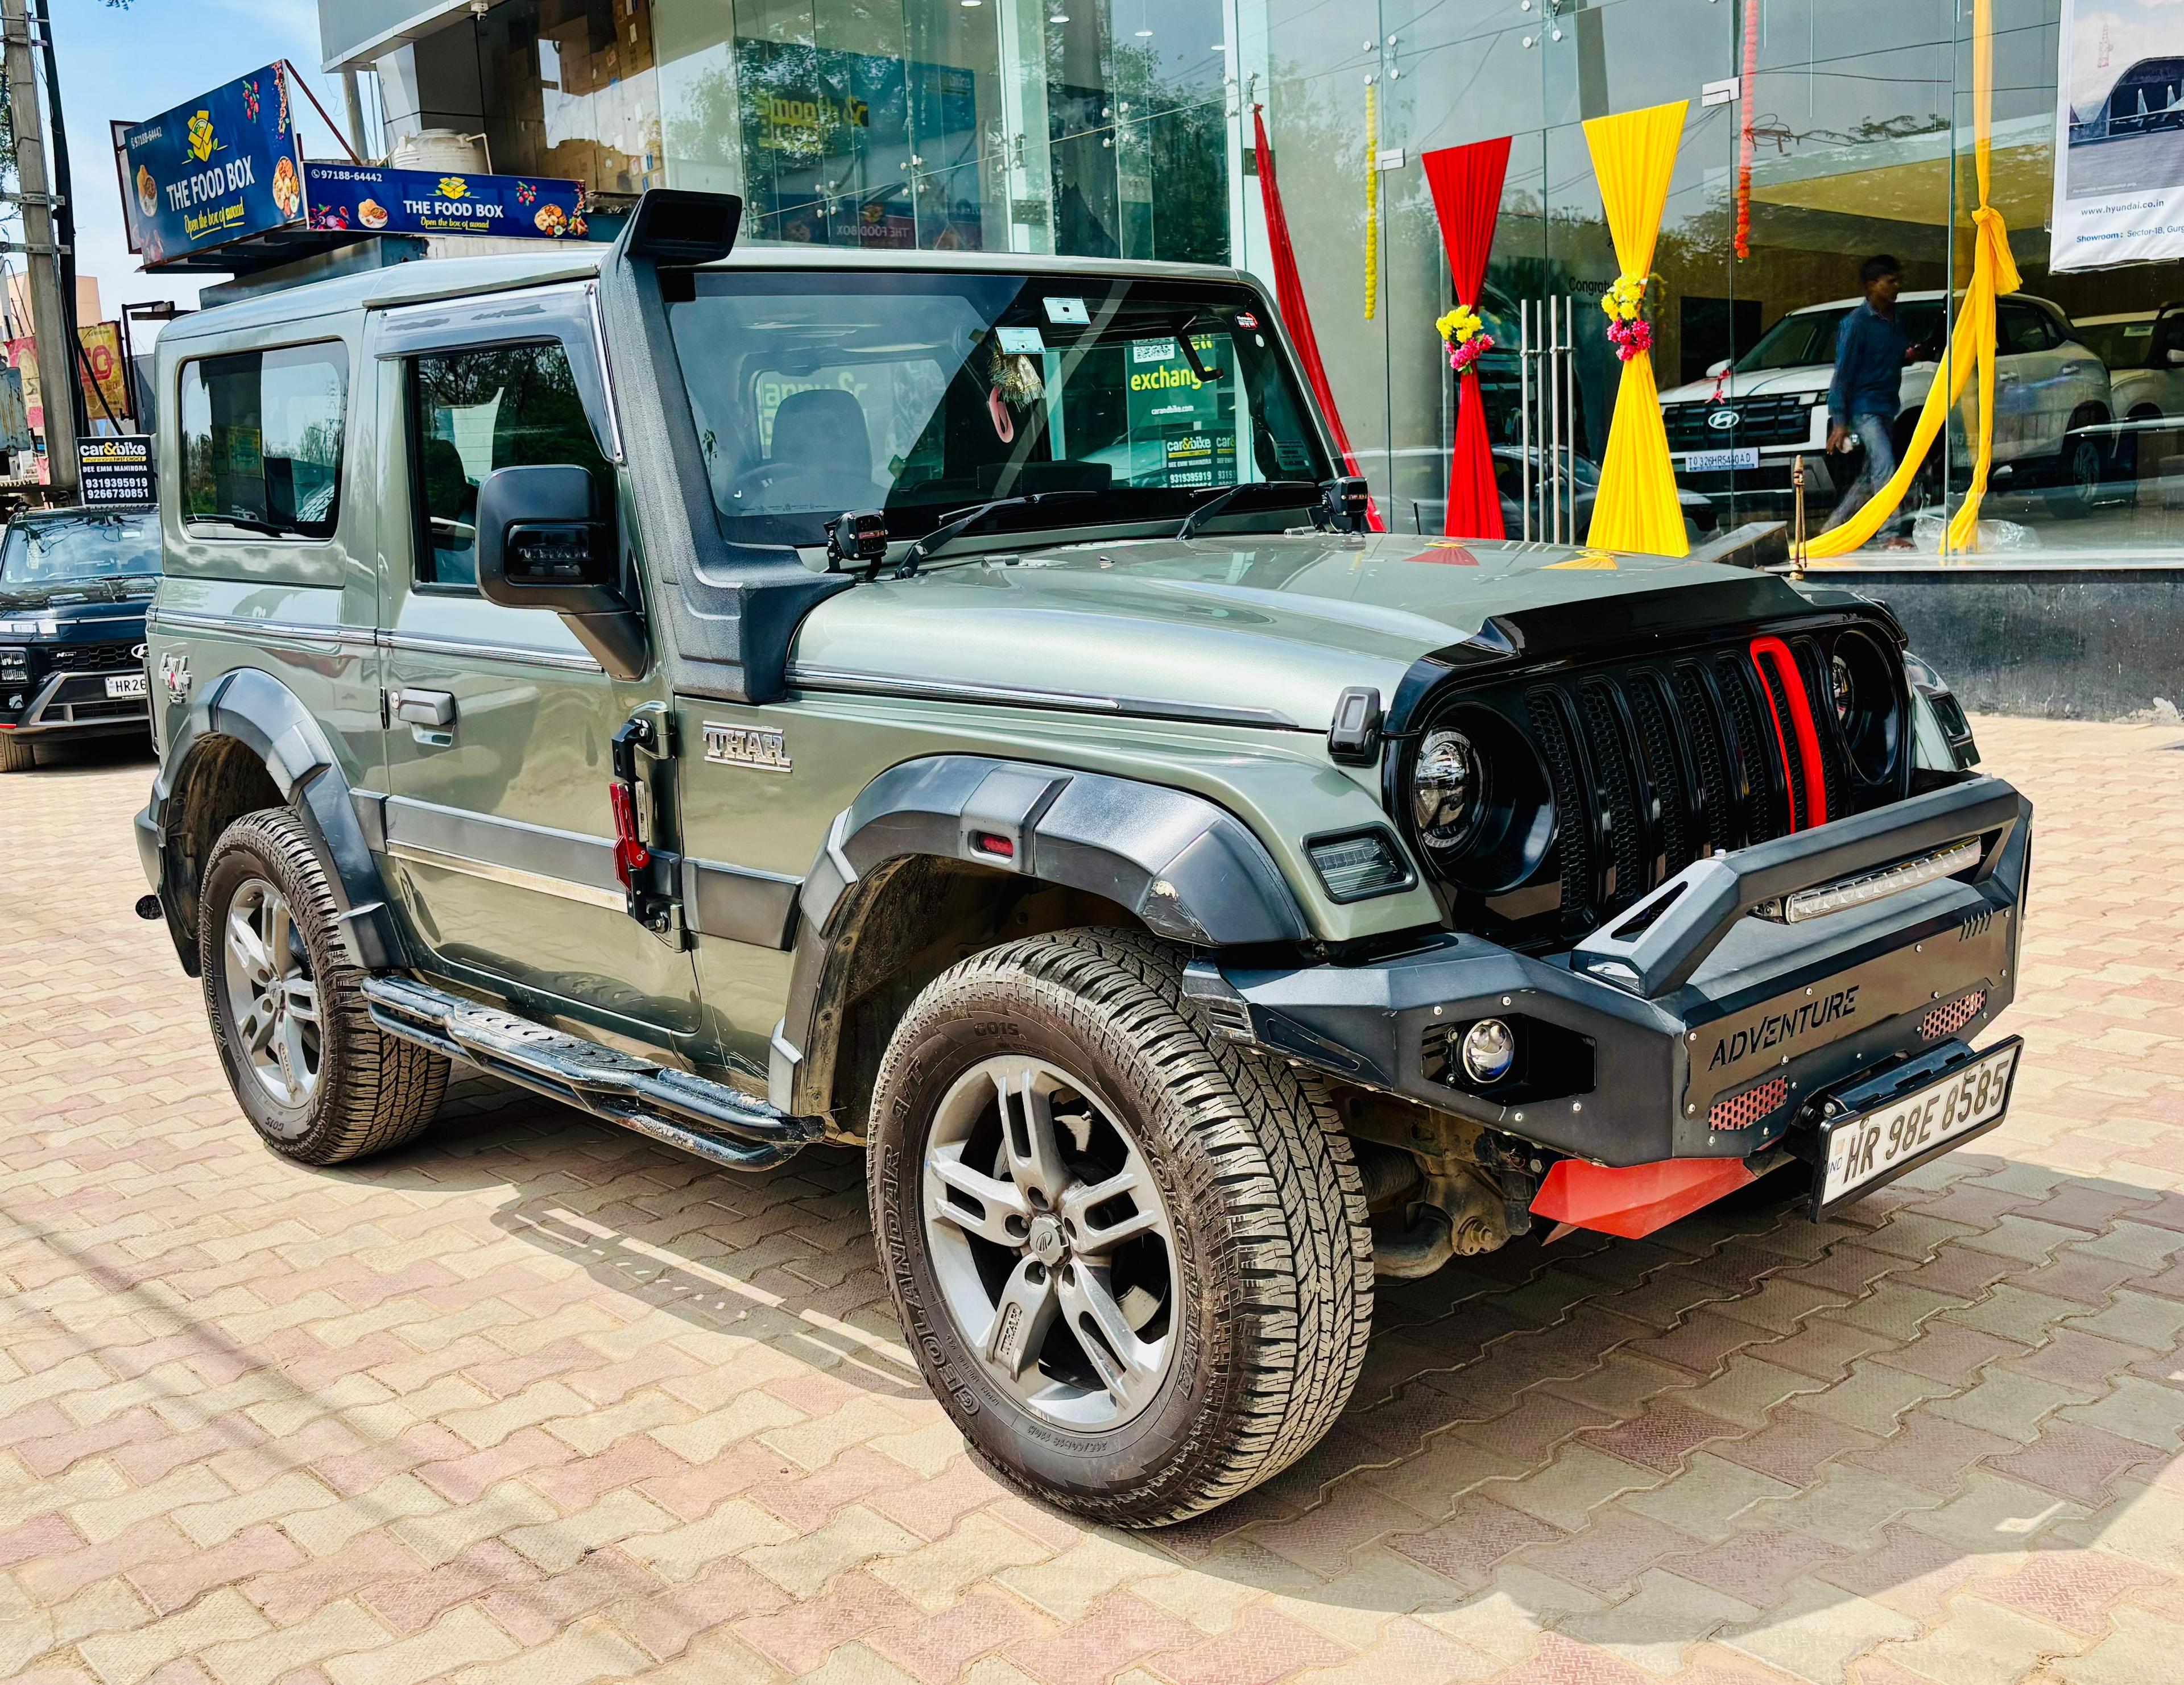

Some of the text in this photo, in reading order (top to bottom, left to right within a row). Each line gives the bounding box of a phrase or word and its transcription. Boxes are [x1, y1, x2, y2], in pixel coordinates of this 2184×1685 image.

[166, 155, 255, 212] THE FOOD BOX
[321, 170, 383, 182] 97188-64442
[403, 200, 504, 218] THE FOOD BOX
[2081, 199, 2164, 216] www.hyundai.co.in
[184, 214, 200, 234] Open
[198, 208, 208, 228] the
[207, 208, 219, 225] box
[421, 216, 437, 228] Open
[438, 217, 448, 226] the
[449, 217, 461, 227] box
[2127, 227, 2165, 238] Sector-18,
[1180, 334, 1213, 352] ell
[80, 442, 147, 456] car&bike
[1167, 436, 1211, 452] car&bike
[85, 478, 148, 488] 9319395919
[87, 488, 148, 499] 9266730851
[702, 726, 791, 767] THAR
[973, 1022, 1019, 1037] G015
[1707, 984, 1860, 1072] ADVENTURE
[263, 1113, 284, 1132] G015
[1843, 1059, 2010, 1185] HR 98E 8585
[1139, 1124, 1202, 1401] YOKOHAMA
[882, 1143, 981, 1416] GEOLANDAR
